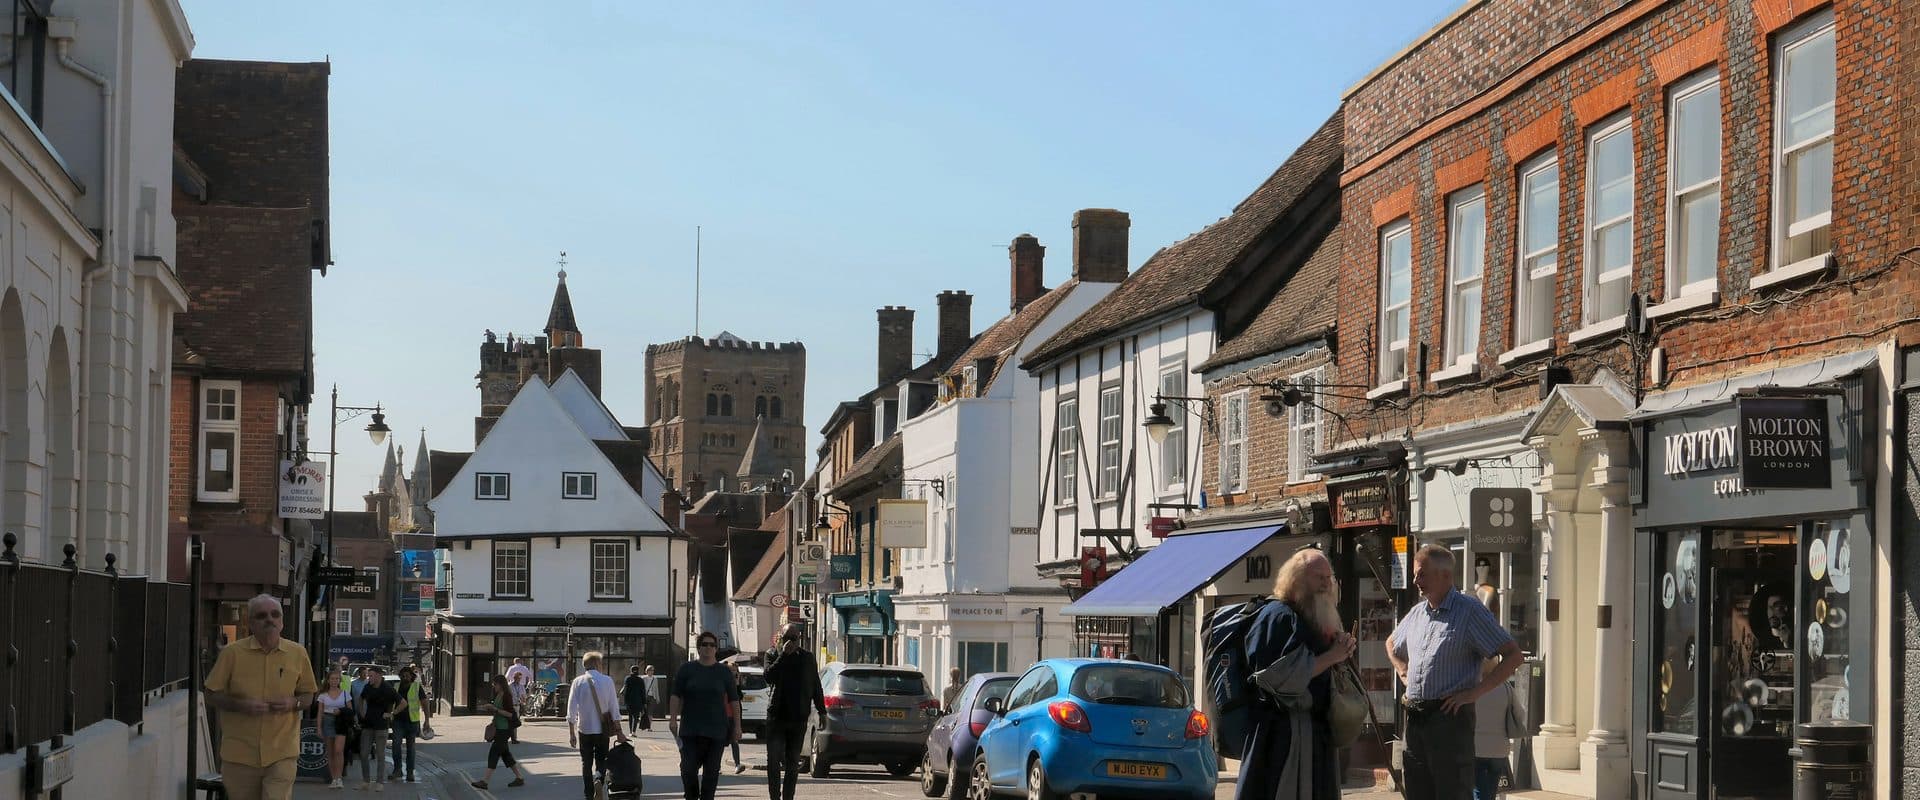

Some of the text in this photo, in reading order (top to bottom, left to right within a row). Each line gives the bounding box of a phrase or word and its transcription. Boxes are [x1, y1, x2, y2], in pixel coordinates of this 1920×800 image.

[1748, 418, 1822, 437] MOLTON
[1664, 425, 1738, 475] MOLTON
[1749, 440, 1825, 457] BROWN
[1763, 462, 1811, 470] LONDON
[1475, 535, 1506, 545] Sweaty
[1245, 555, 1271, 583] JAGO
[343, 585, 371, 593] NERO
[951, 608, 1003, 616] THE PLACE TO BE
[1139, 765, 1160, 777] EYX
